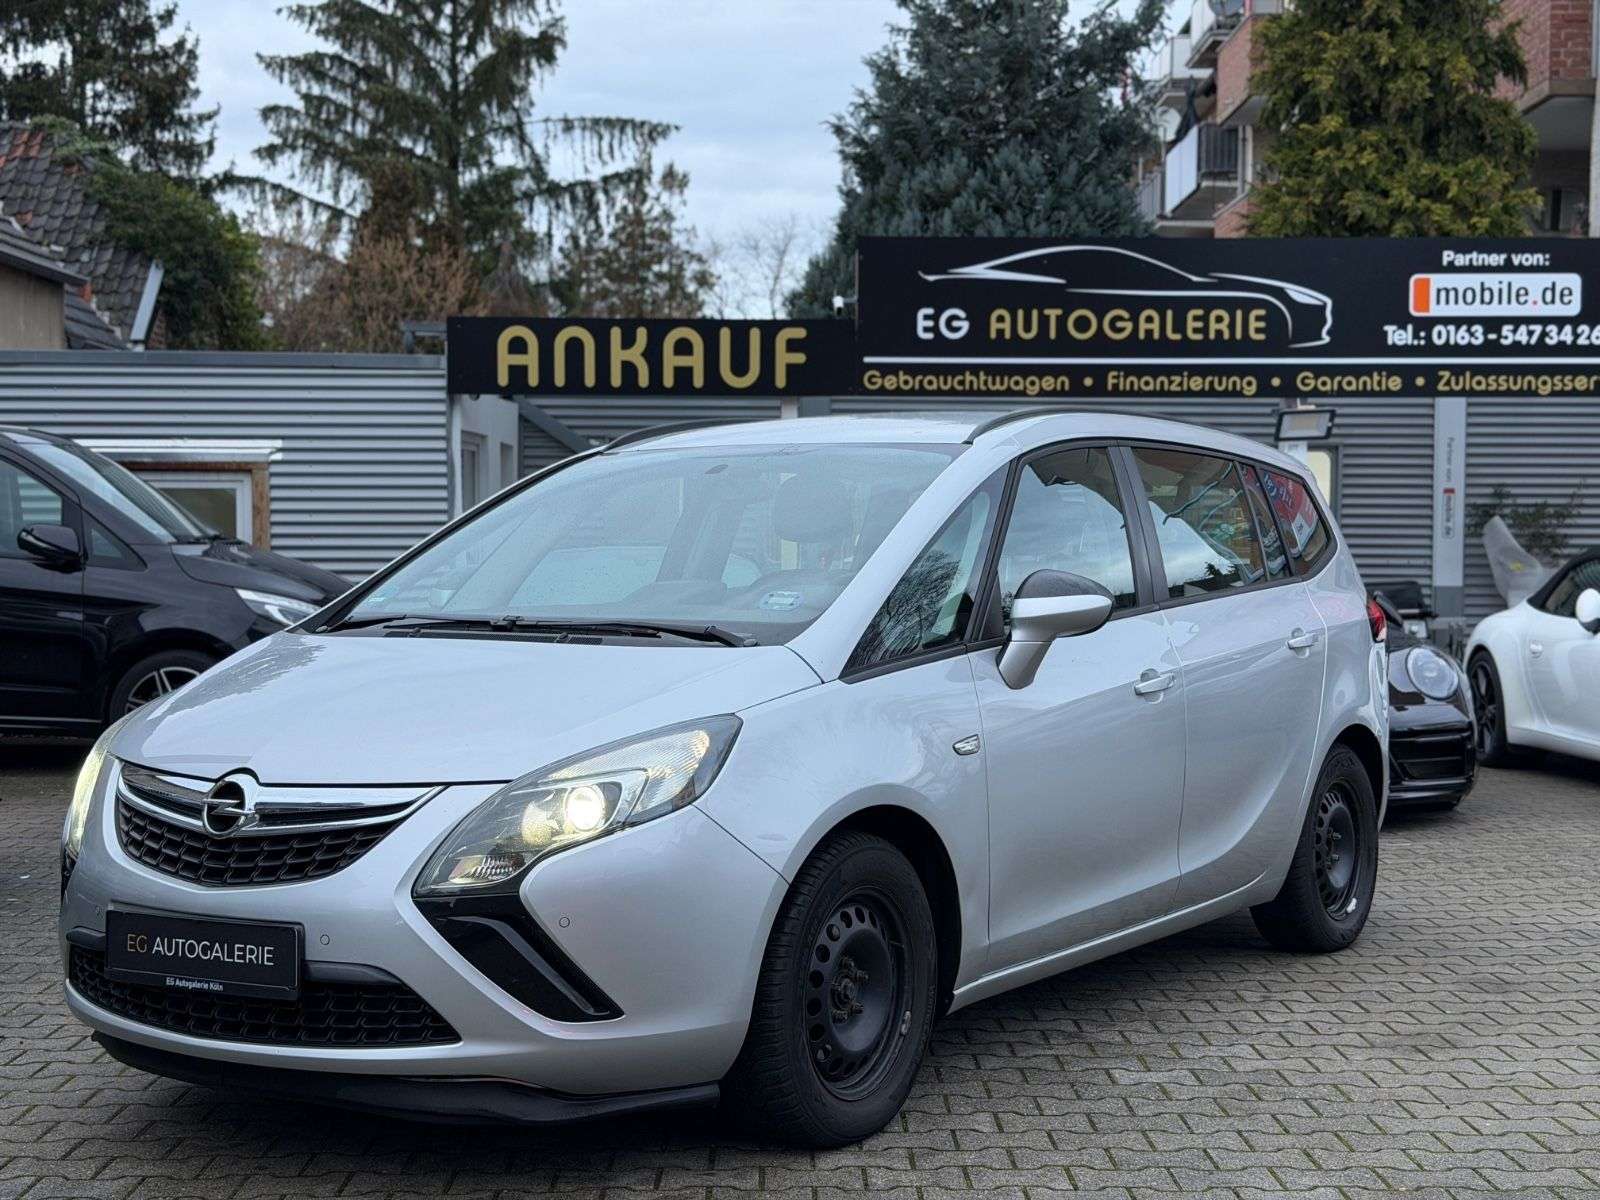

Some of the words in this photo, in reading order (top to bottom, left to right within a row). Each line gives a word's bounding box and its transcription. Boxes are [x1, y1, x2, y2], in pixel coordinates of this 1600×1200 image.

[1441, 249, 1507, 267] Partner
[1511, 252, 1550, 267] von:
[1435, 281, 1573, 306] mobile.de
[916, 307, 970, 340] EG
[989, 308, 1267, 341] AUTOGALERIE
[1382, 323, 1425, 346] Tel.:
[496, 324, 807, 390] ANKAUF
[863, 370, 1069, 396] Gebrauchtwagen
[1107, 371, 1257, 396] Finanzierung
[1296, 370, 1402, 393] Garantie
[1436, 370, 1600, 396] Zulassungsser
[127, 933, 147, 953] EG
[151, 936, 275, 966] AUTOGALERIE
[166, 977, 174, 986] EG
[175, 977, 209, 990] Autogalerie
[209, 981, 224, 991] Köln
